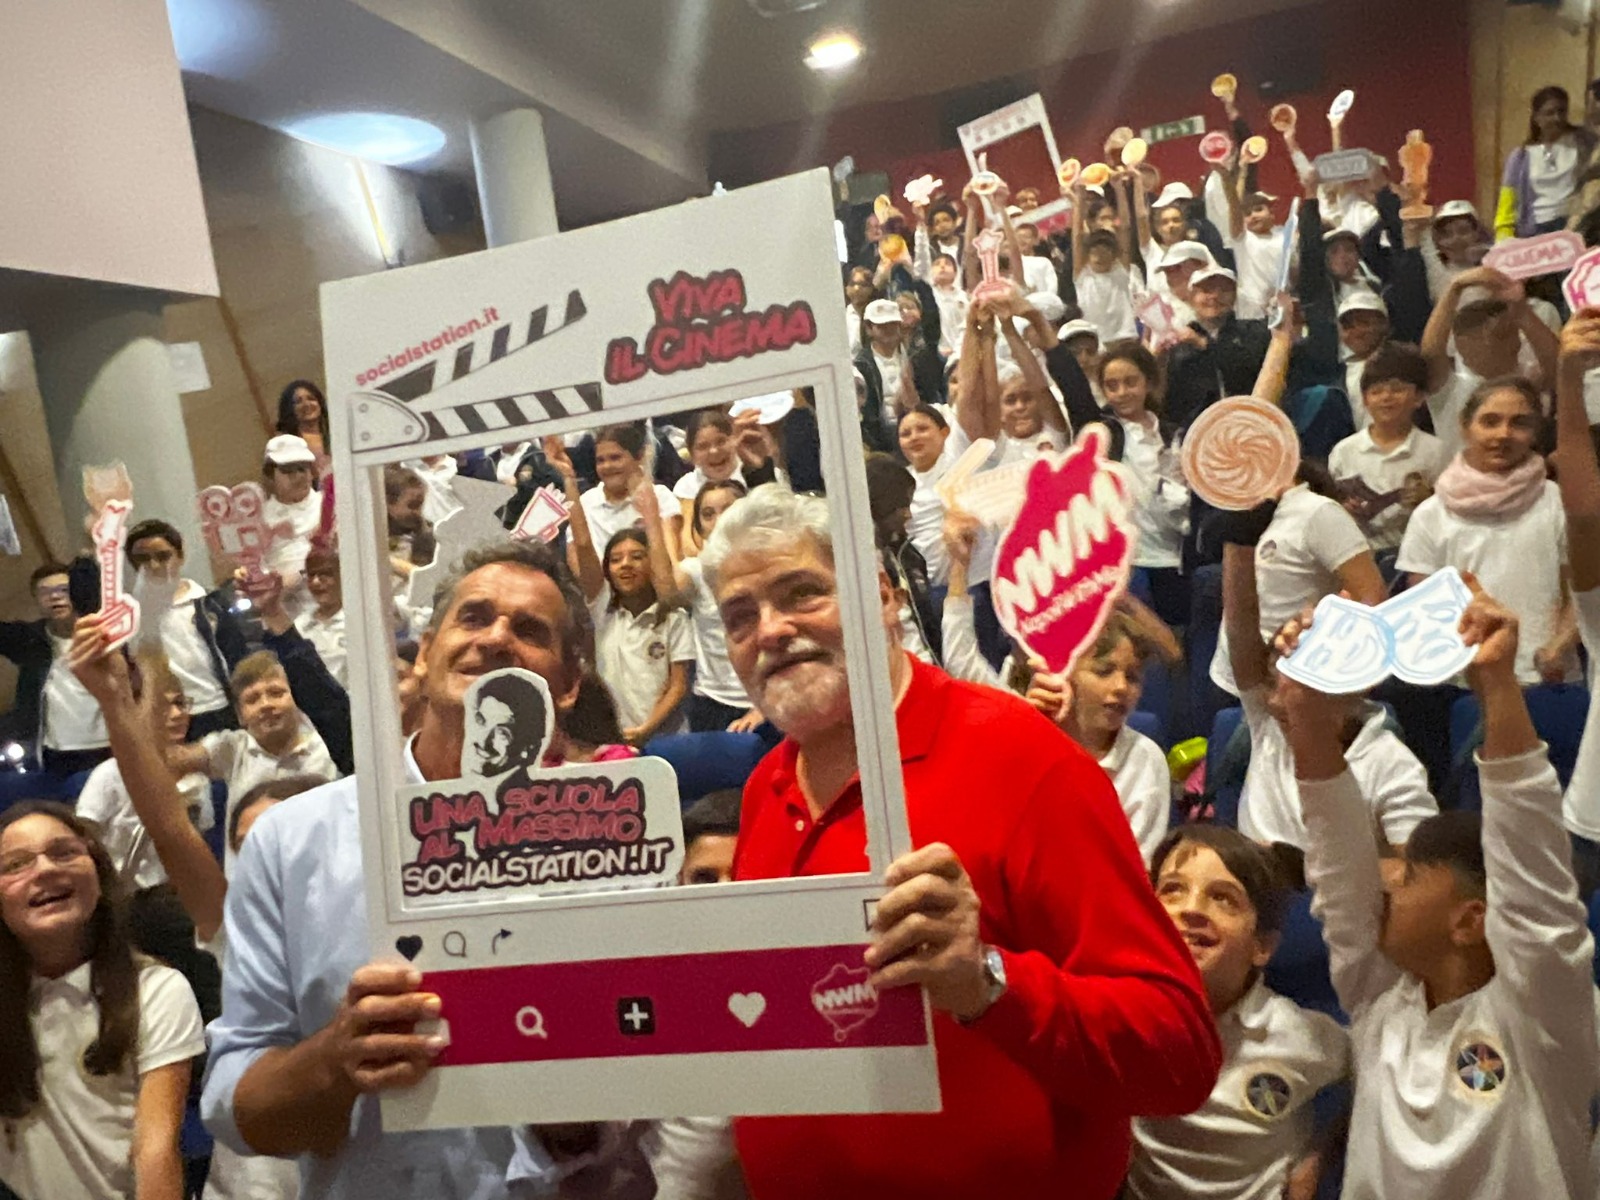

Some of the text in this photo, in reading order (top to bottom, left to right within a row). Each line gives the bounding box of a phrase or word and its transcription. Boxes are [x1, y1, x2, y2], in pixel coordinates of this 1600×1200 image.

[649, 270, 745, 324] VIVA
[355, 306, 499, 387] socialstation.it
[605, 302, 816, 384] IL CINEMA
[411, 779, 644, 838] UNA SCUOLA
[418, 812, 645, 863] AL MASSIMO
